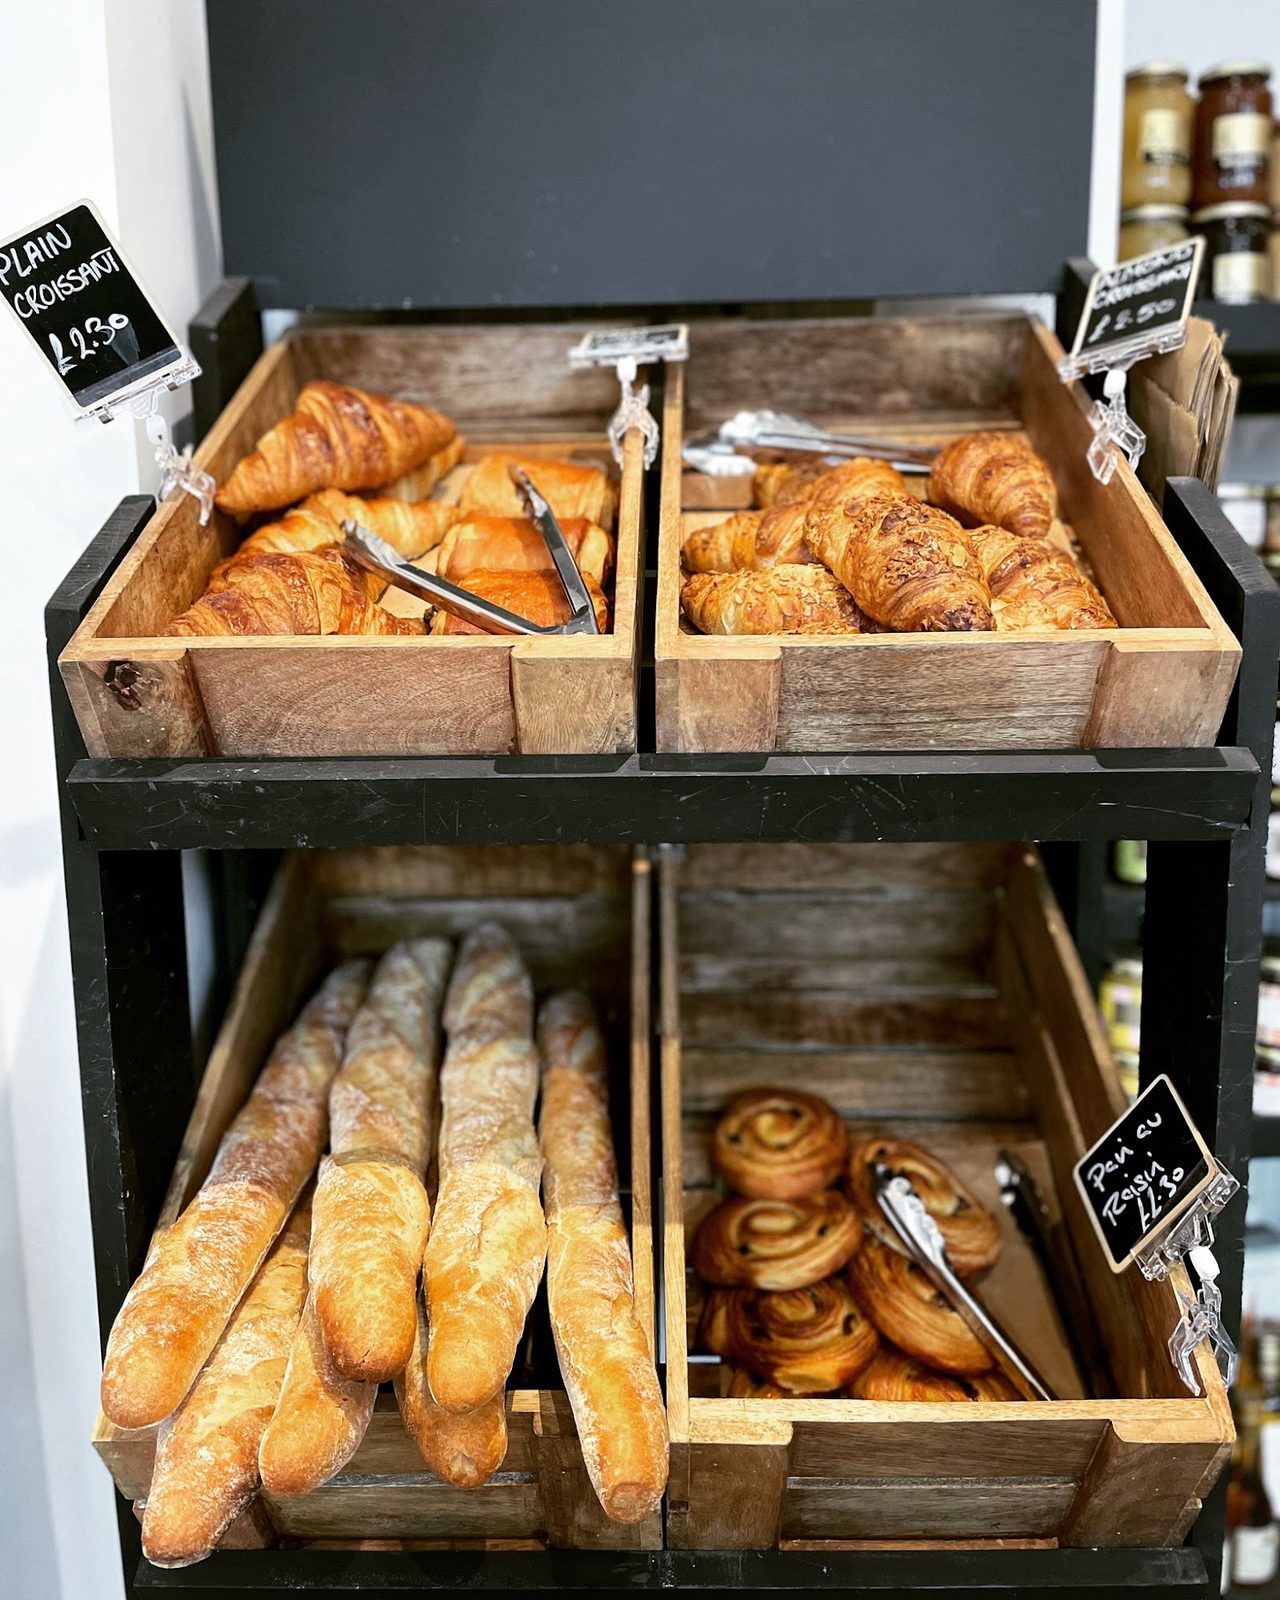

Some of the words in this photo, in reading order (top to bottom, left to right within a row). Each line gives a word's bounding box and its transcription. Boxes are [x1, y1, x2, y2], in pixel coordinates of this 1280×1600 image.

[0, 224, 72, 286] PLAIN
[14, 247, 120, 318] CROISSANT
[49, 313, 129, 376] £2.30
[1136, 1112, 1162, 1139] au
[1102, 1151, 1165, 1226] Raisin
